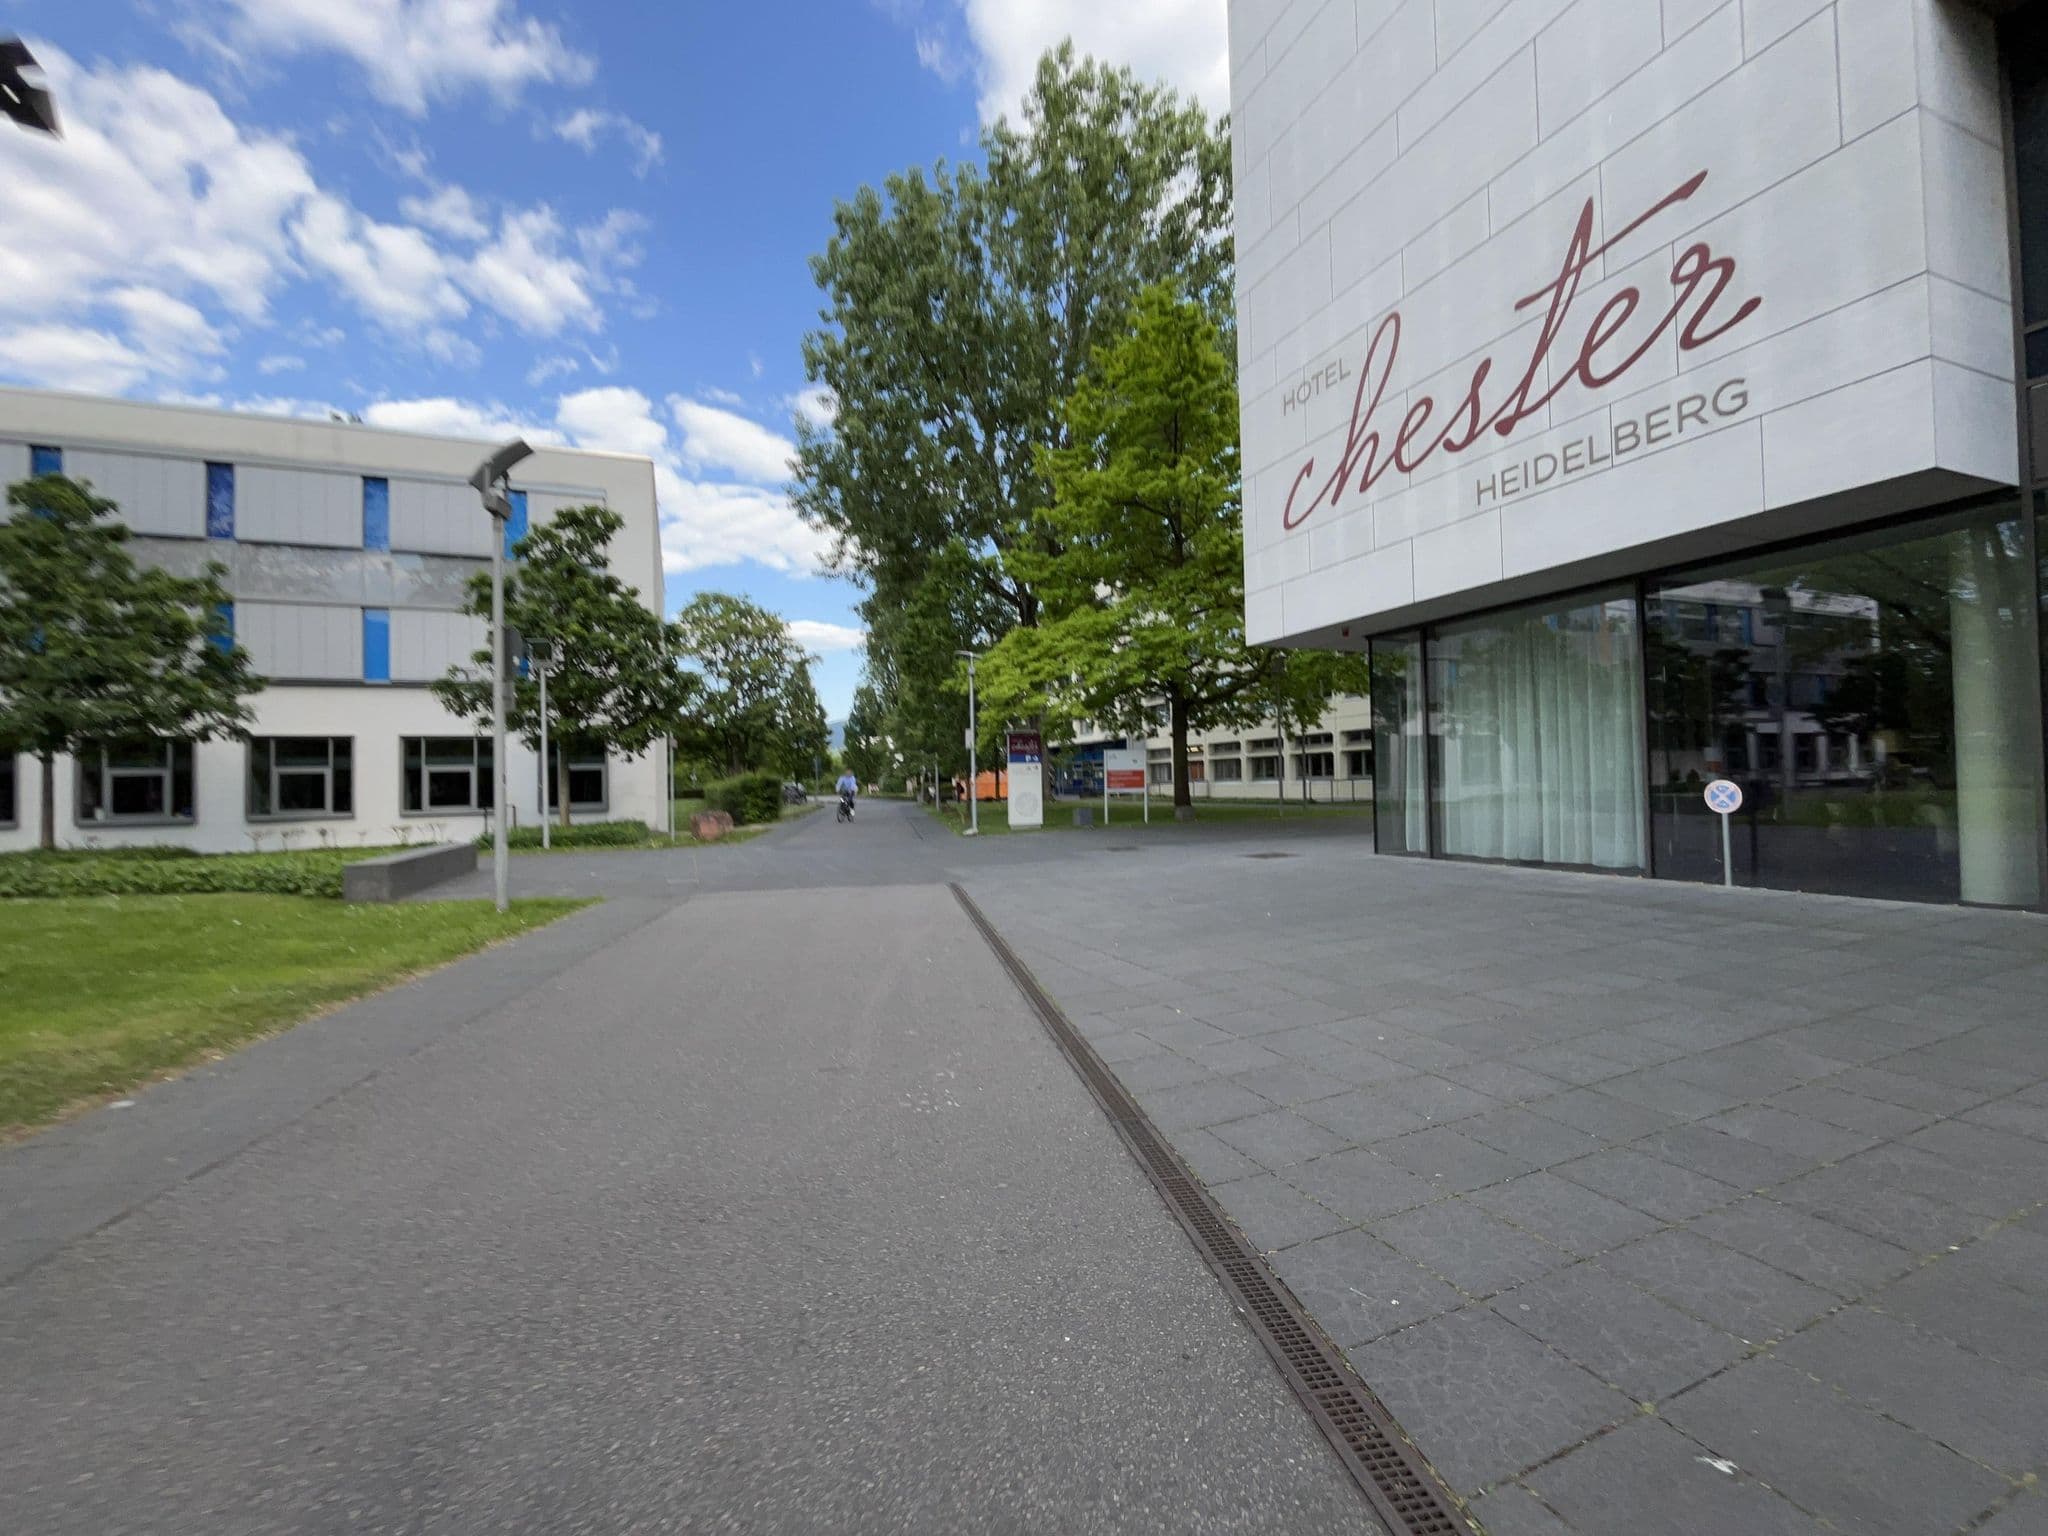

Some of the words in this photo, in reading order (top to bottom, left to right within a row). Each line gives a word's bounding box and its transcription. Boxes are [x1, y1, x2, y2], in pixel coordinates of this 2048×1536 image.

[1282, 357, 1351, 416] HOTEL
[1283, 168, 1762, 530] chester
[1476, 378, 1749, 506] HEIDELBERG
